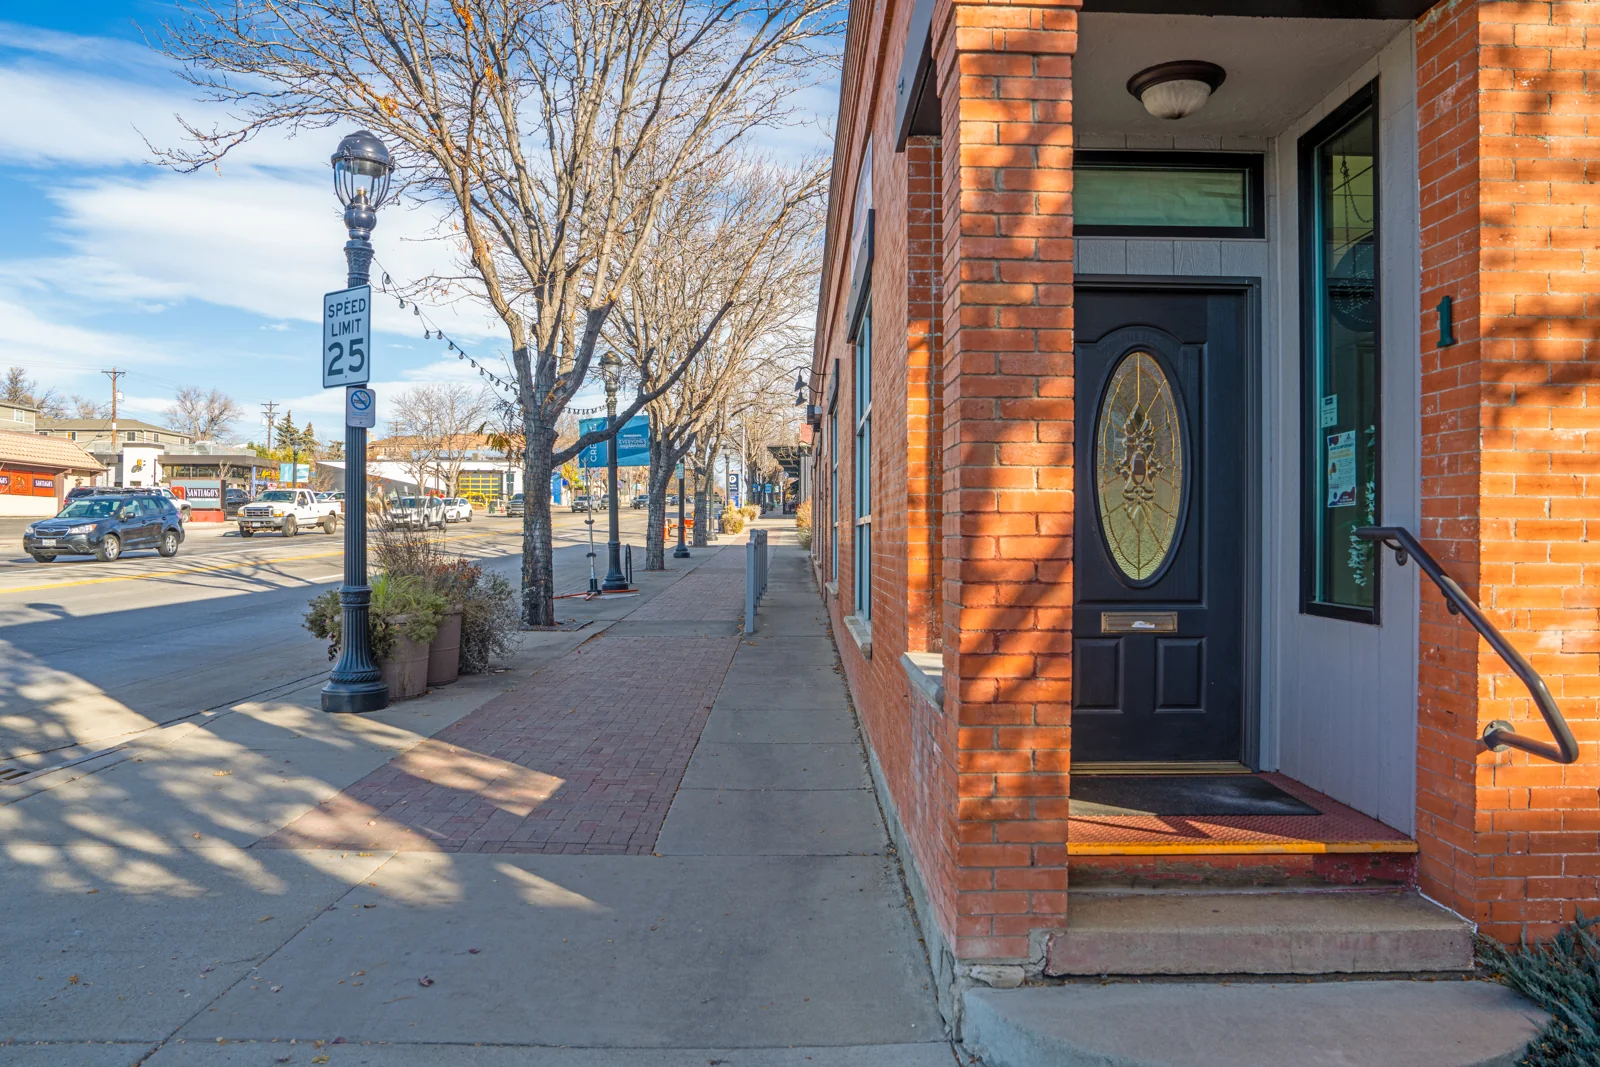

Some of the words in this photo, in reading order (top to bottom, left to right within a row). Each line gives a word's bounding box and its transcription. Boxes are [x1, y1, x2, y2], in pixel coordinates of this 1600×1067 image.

[328, 298, 366, 318] SPEED
[1436, 295, 1455, 348] 1
[331, 318, 362, 337] LIMIT
[327, 338, 365, 376] 25
[589, 423, 598, 462] CREE.
[187, 488, 219, 497] SANTIAGO'S
